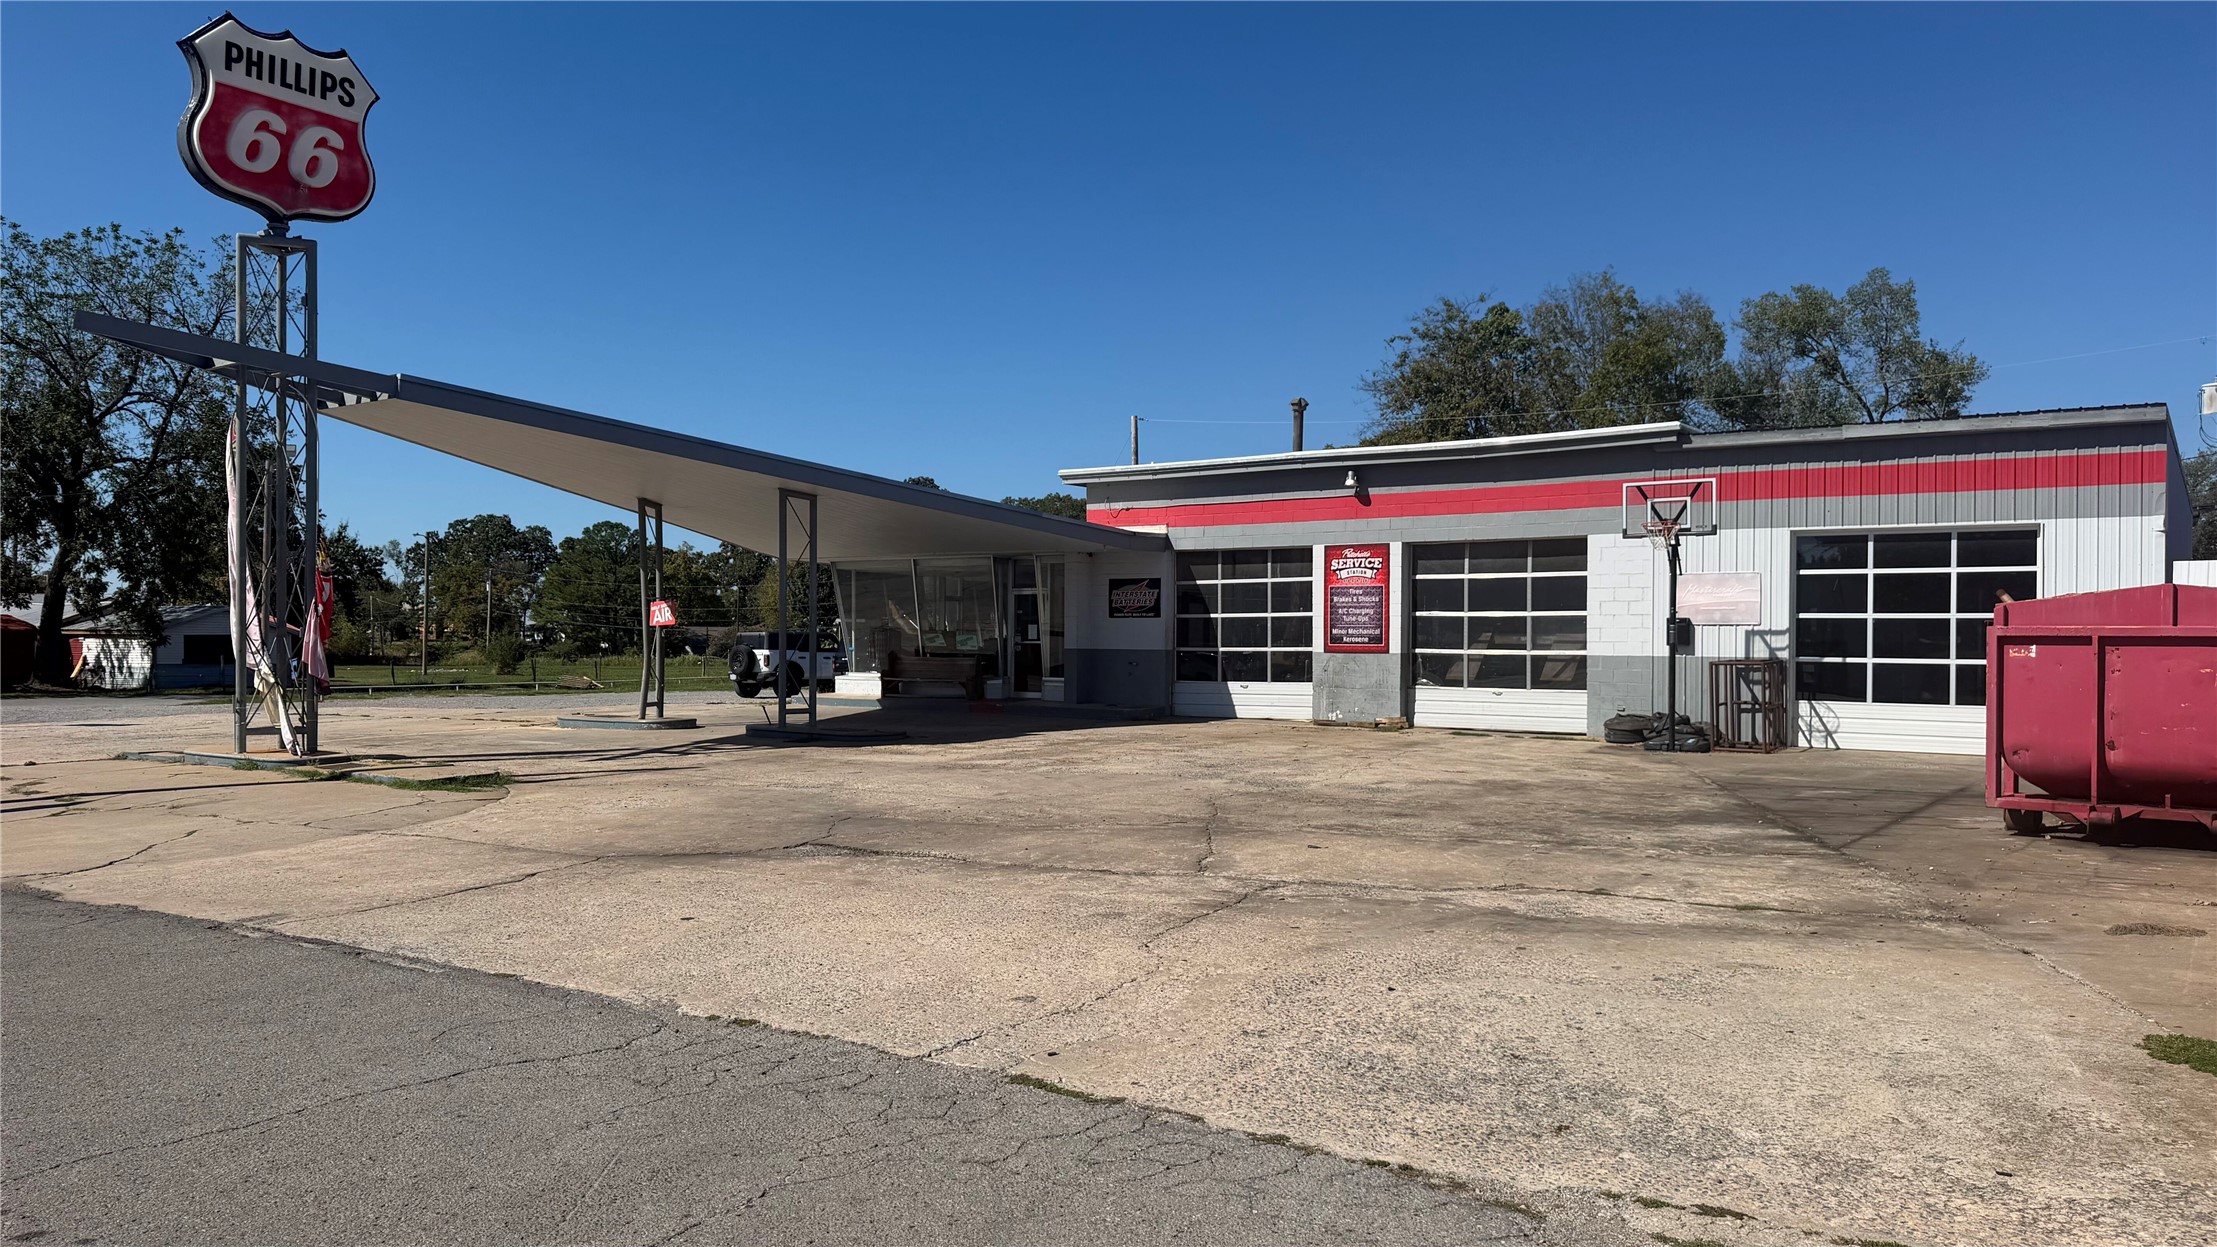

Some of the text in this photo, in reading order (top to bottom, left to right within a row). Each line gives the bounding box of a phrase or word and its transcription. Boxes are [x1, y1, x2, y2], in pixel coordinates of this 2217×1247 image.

[224, 40, 356, 108] PHILLIPS
[227, 109, 345, 189] 66
[1330, 557, 1383, 571] SERVICE
[653, 607, 673, 624] AIR
